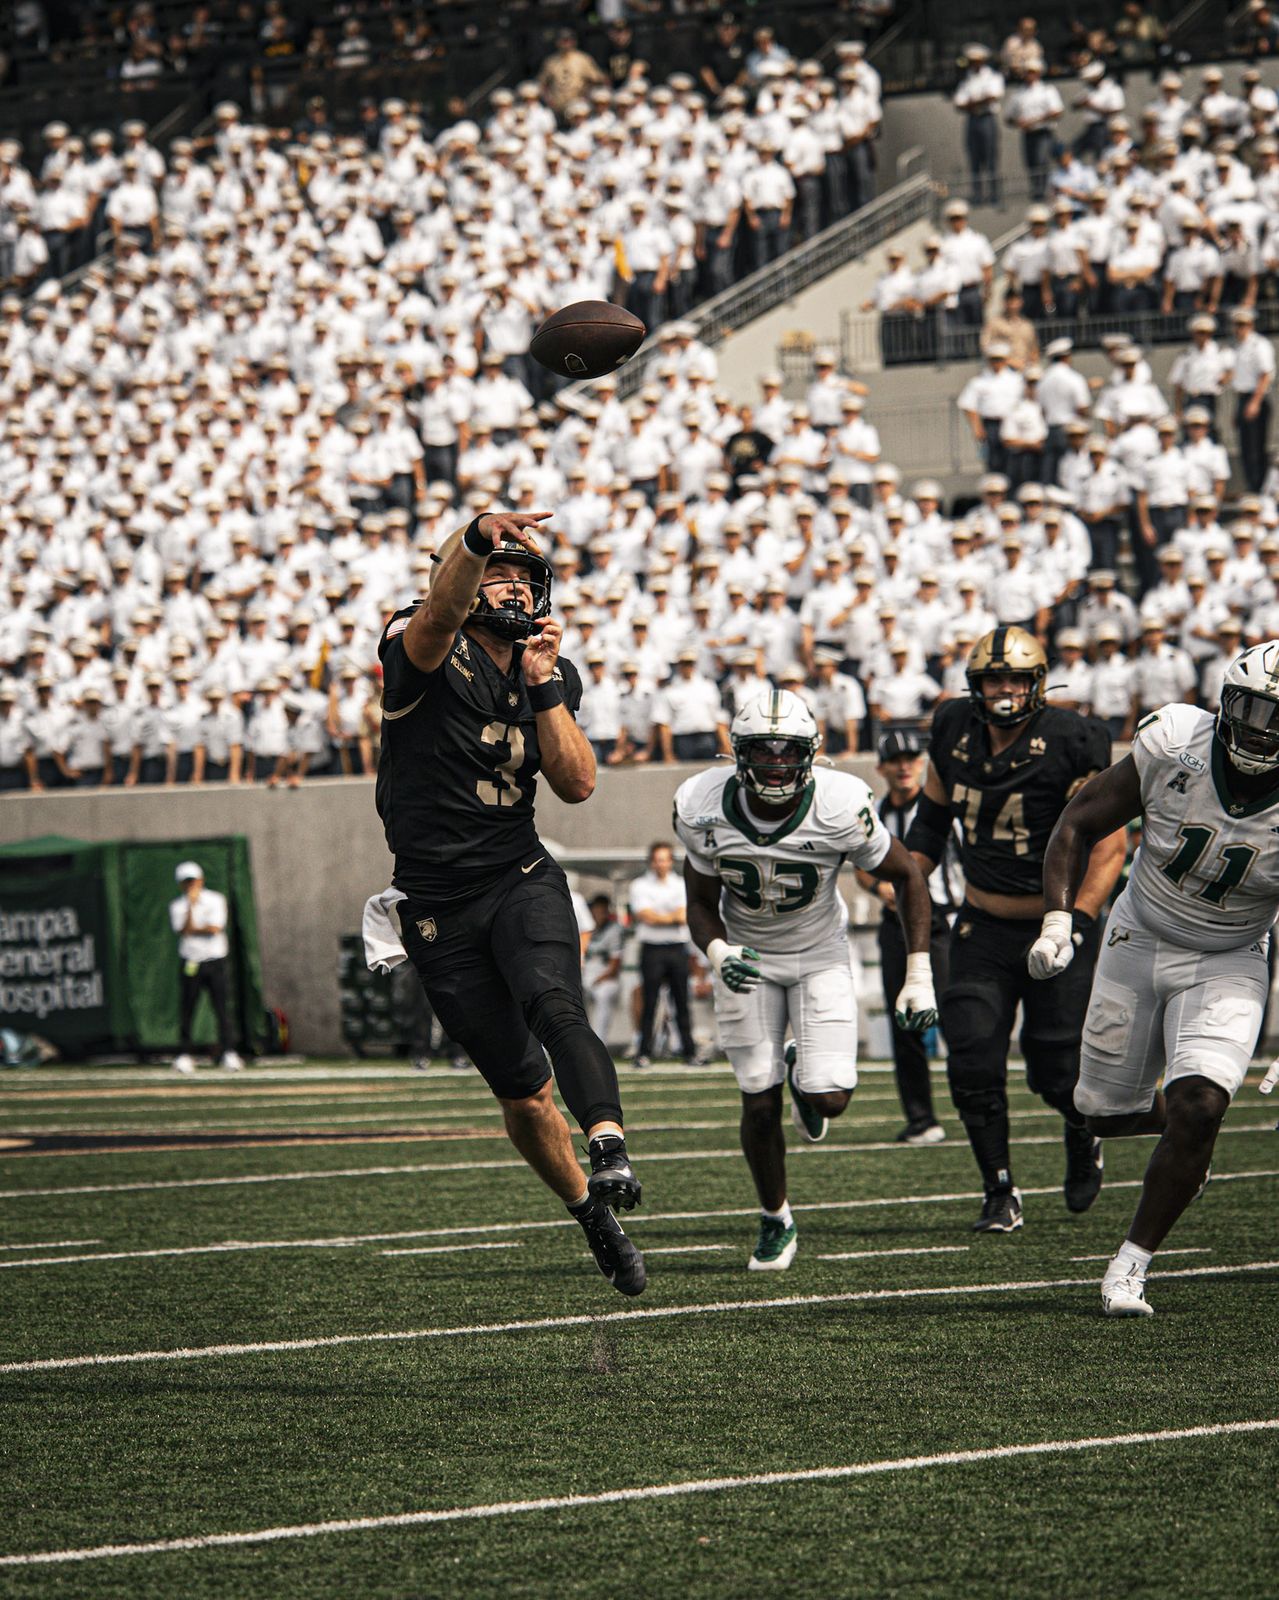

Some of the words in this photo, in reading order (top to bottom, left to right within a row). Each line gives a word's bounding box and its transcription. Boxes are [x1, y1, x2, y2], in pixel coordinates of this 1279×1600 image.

[475, 720, 526, 808] 3
[1183, 752, 1206, 770] TGH
[703, 828, 719, 849] A
[951, 782, 1031, 857] 74
[715, 855, 823, 918] 33
[1157, 822, 1261, 911] 11
[0, 971, 104, 1019] ospital
